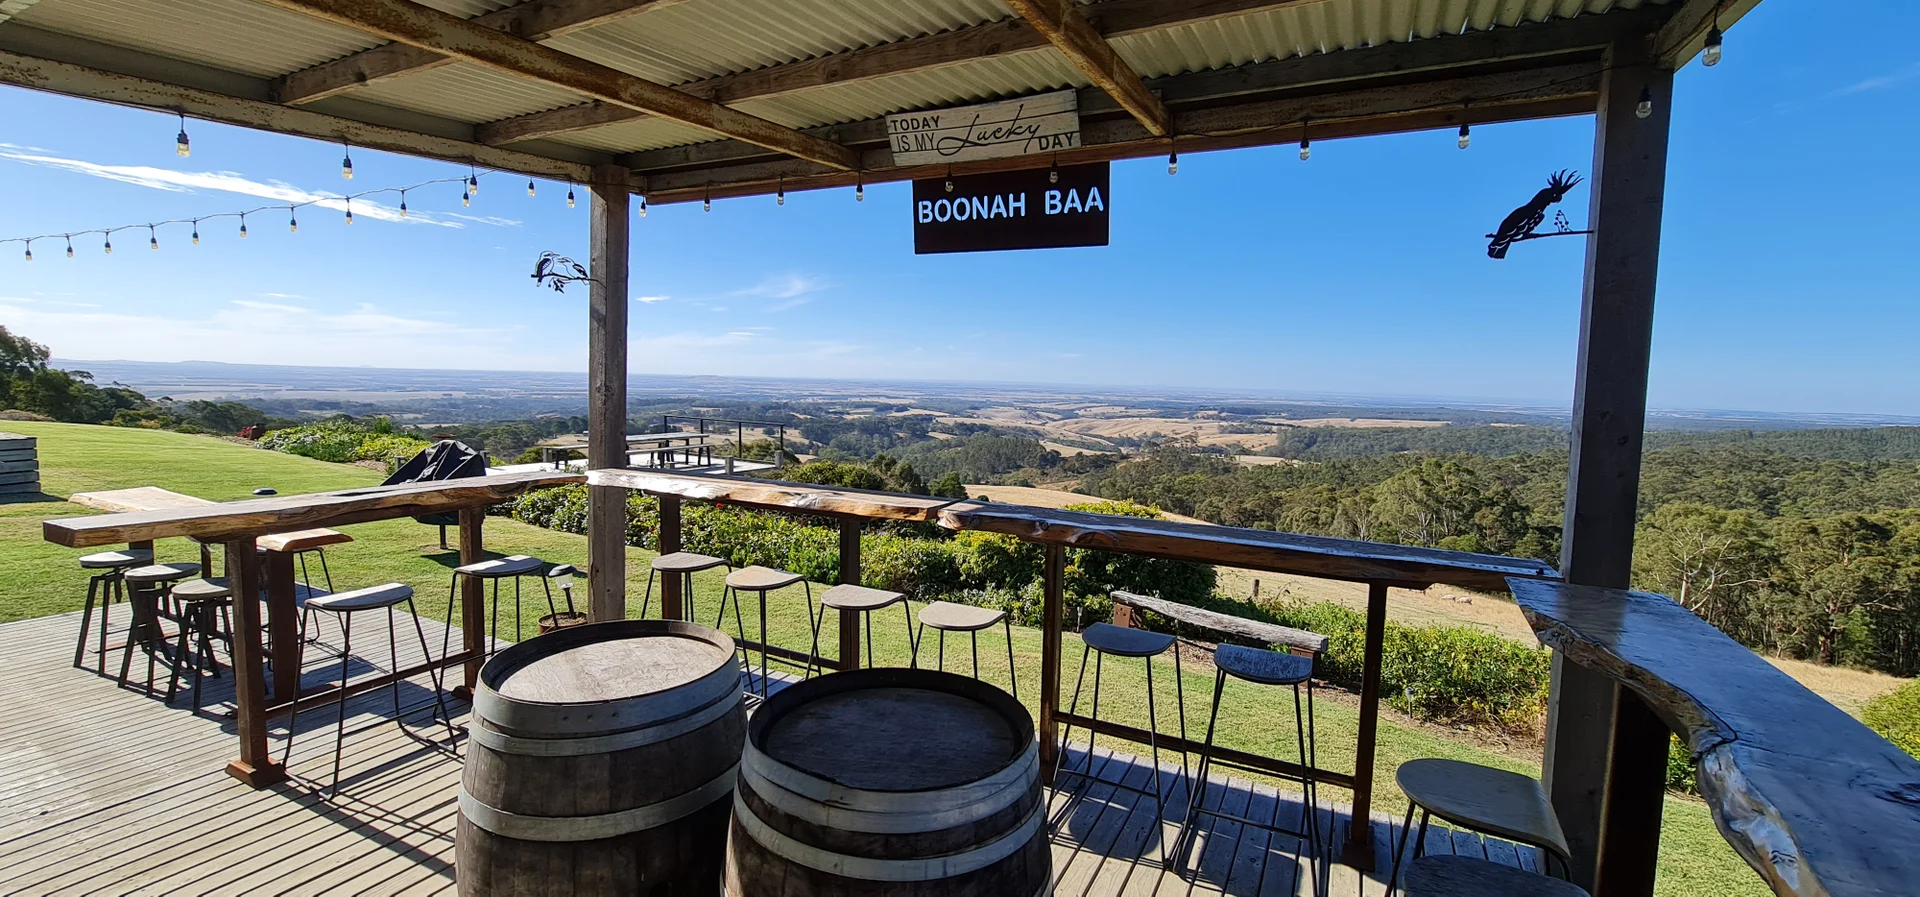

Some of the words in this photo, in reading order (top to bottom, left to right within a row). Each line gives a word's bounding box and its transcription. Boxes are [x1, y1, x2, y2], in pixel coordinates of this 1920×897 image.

[890, 115, 940, 132] TODAY
[937, 103, 1041, 157] Lucky
[896, 134, 911, 152] IS
[914, 132, 935, 151] MY
[1038, 133, 1074, 151] DAY
[918, 192, 1026, 224] BOONAH
[1044, 186, 1104, 215] BAA
